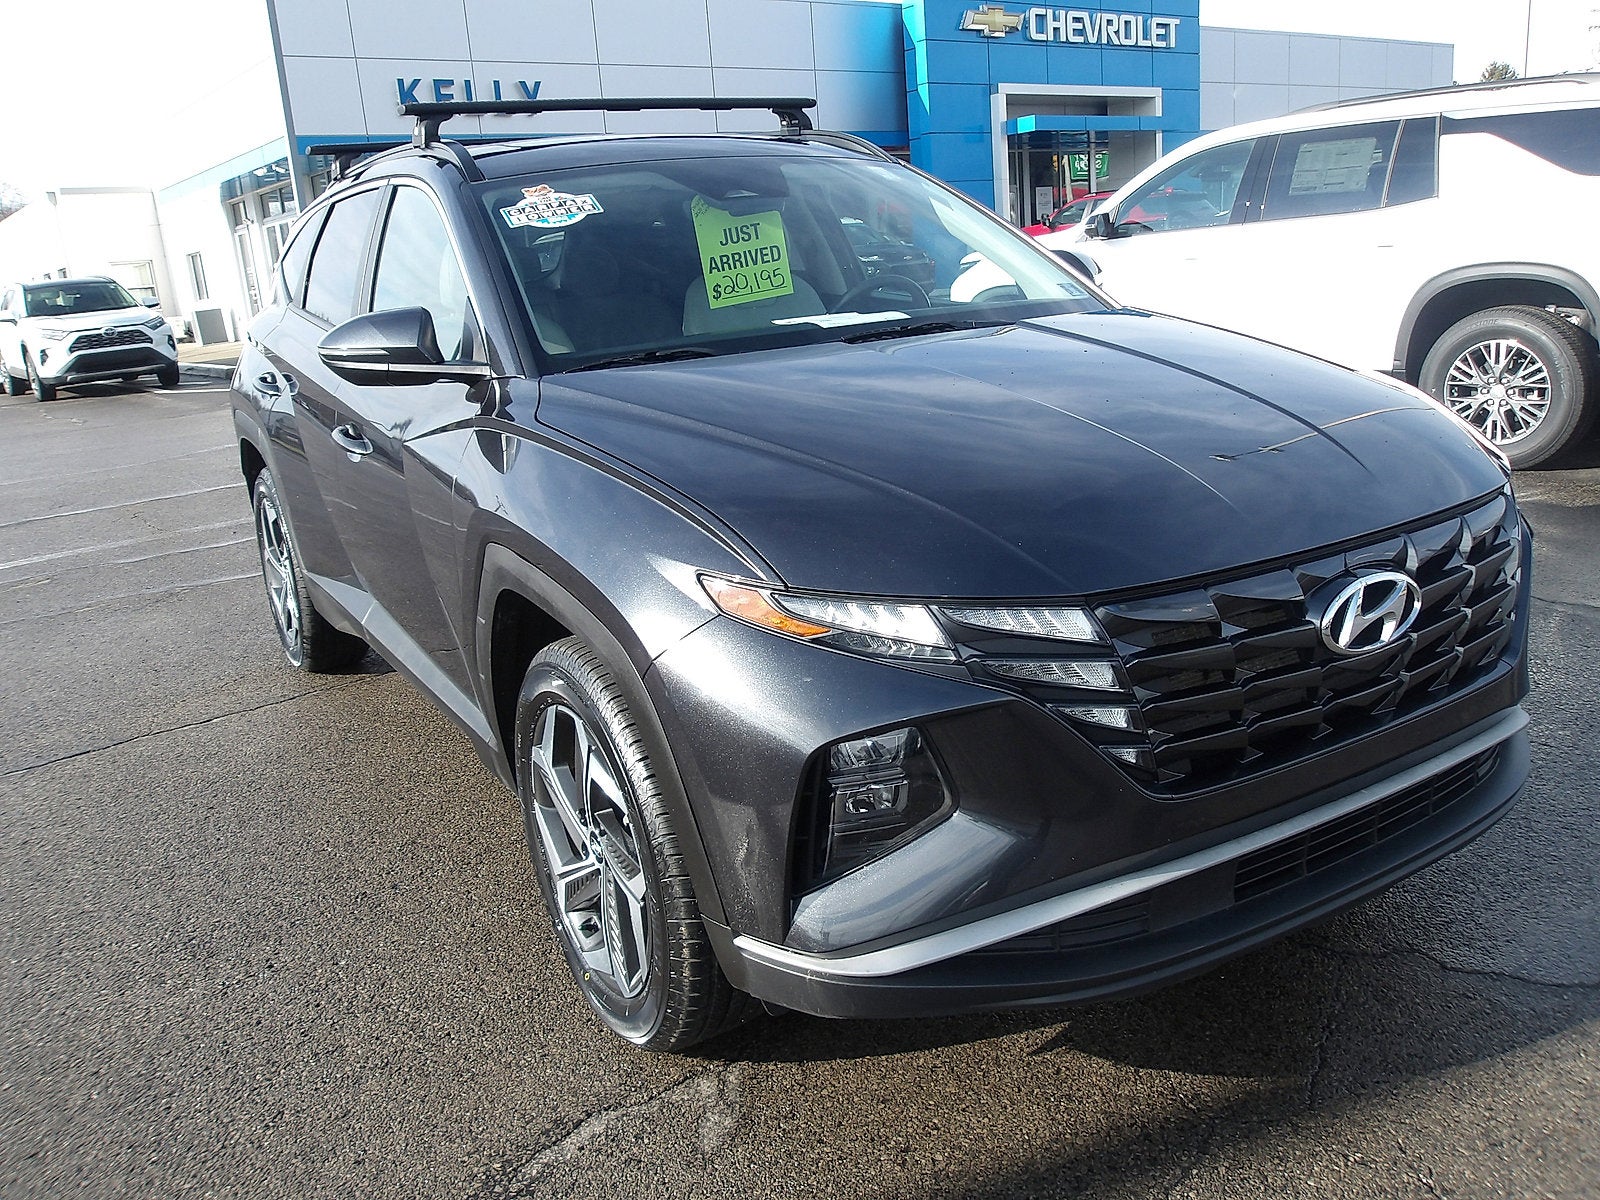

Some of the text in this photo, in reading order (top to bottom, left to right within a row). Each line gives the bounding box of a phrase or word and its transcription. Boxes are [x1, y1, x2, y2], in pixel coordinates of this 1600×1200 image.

[1027, 8, 1181, 48] CHEVROLET
[719, 222, 760, 246] JUST
[708, 245, 781, 274] ARRIVED
[712, 267, 786, 301] $20,195
